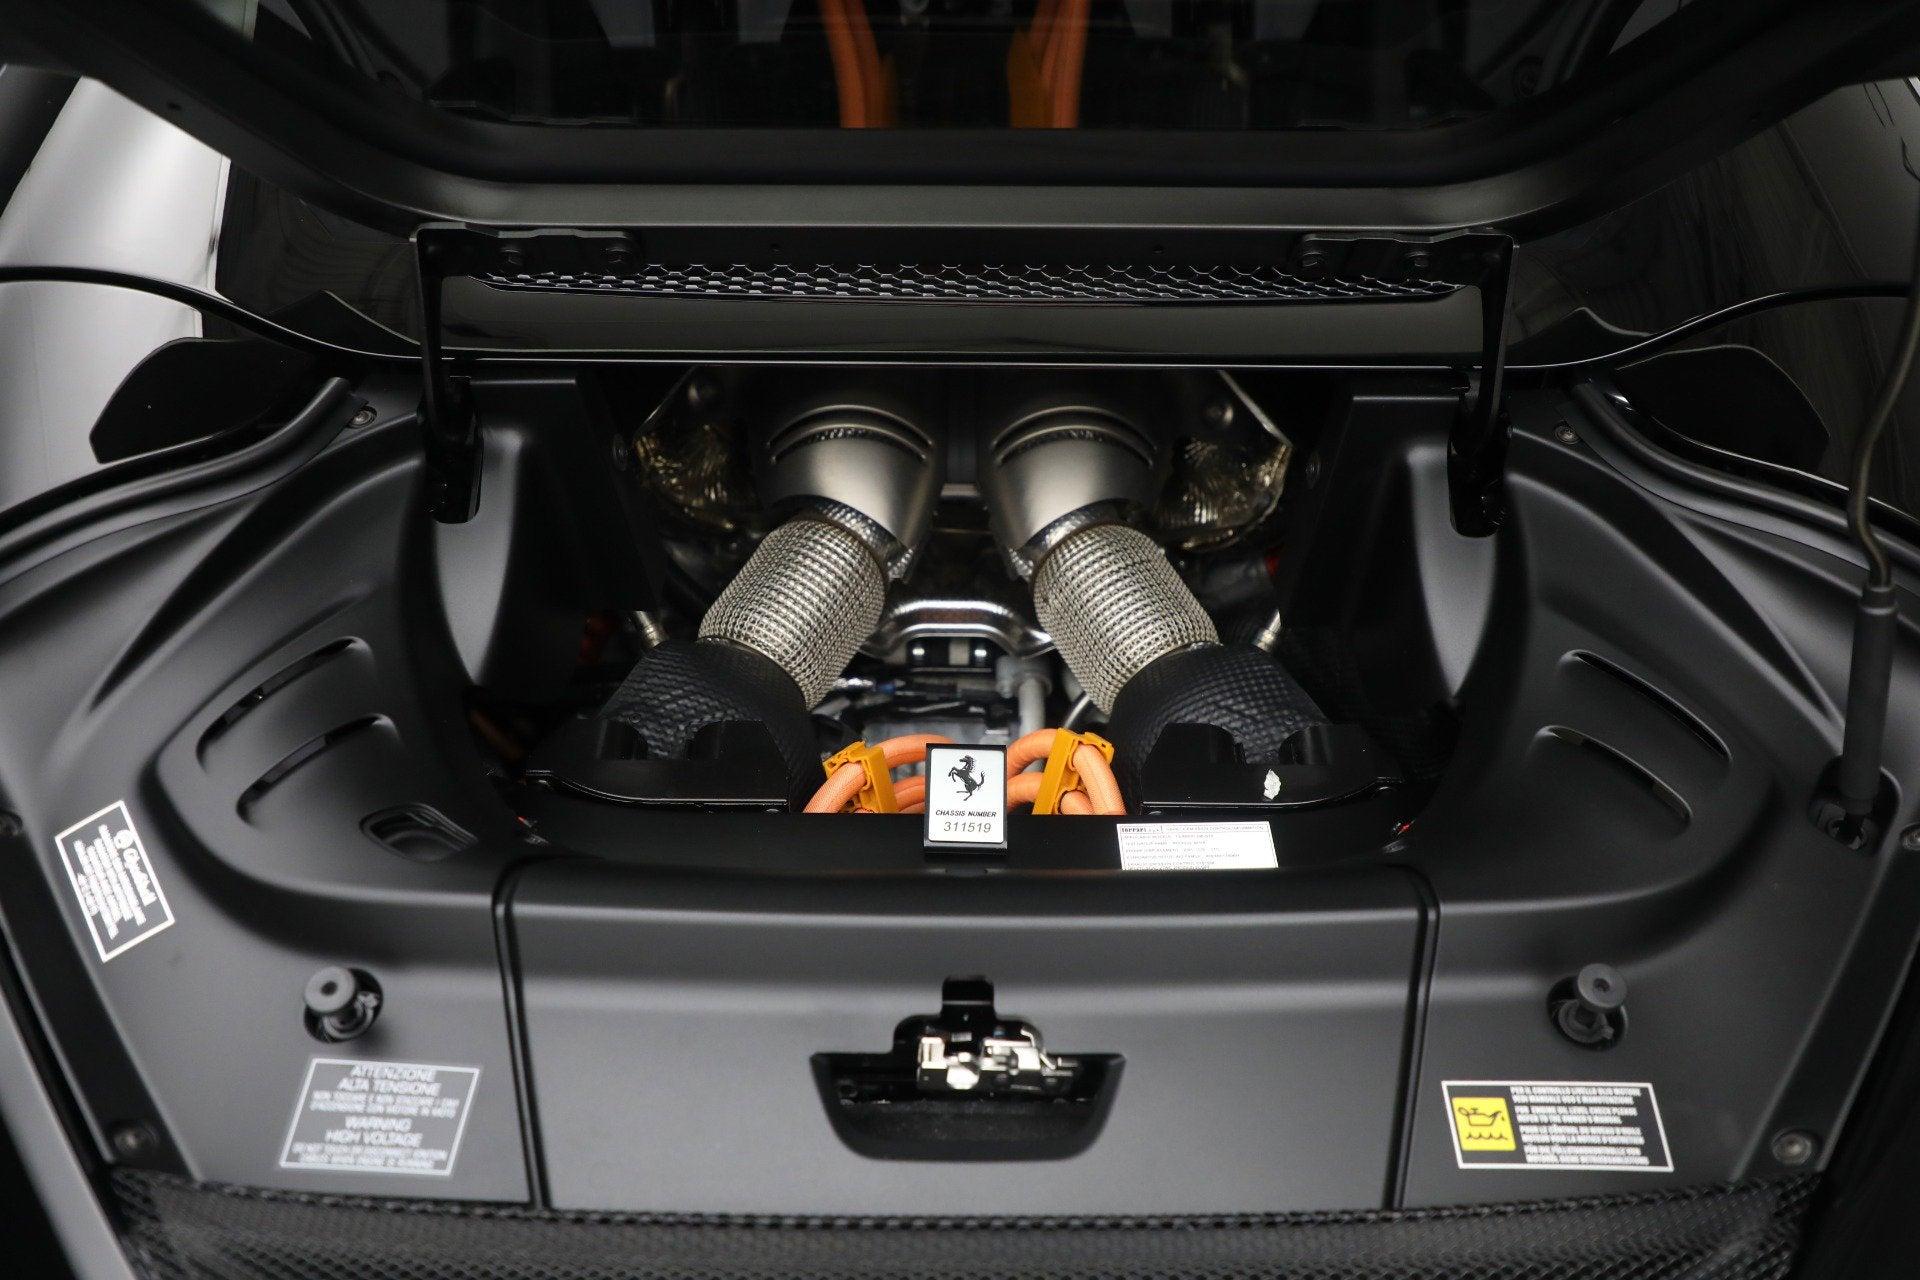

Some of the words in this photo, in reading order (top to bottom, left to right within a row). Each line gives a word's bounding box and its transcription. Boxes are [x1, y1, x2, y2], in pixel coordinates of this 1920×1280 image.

[935, 809, 966, 817] CHASSIS
[967, 810, 997, 818] NUMBER
[943, 821, 992, 833] 311519
[350, 1064, 437, 1082] ATTENZIONE
[337, 1077, 370, 1092] ALTA
[373, 1080, 442, 1096] TENSIONE
[345, 1115, 413, 1132] WARNING
[324, 1128, 362, 1144] HIGH
[363, 1131, 424, 1148] VOLTAGE
